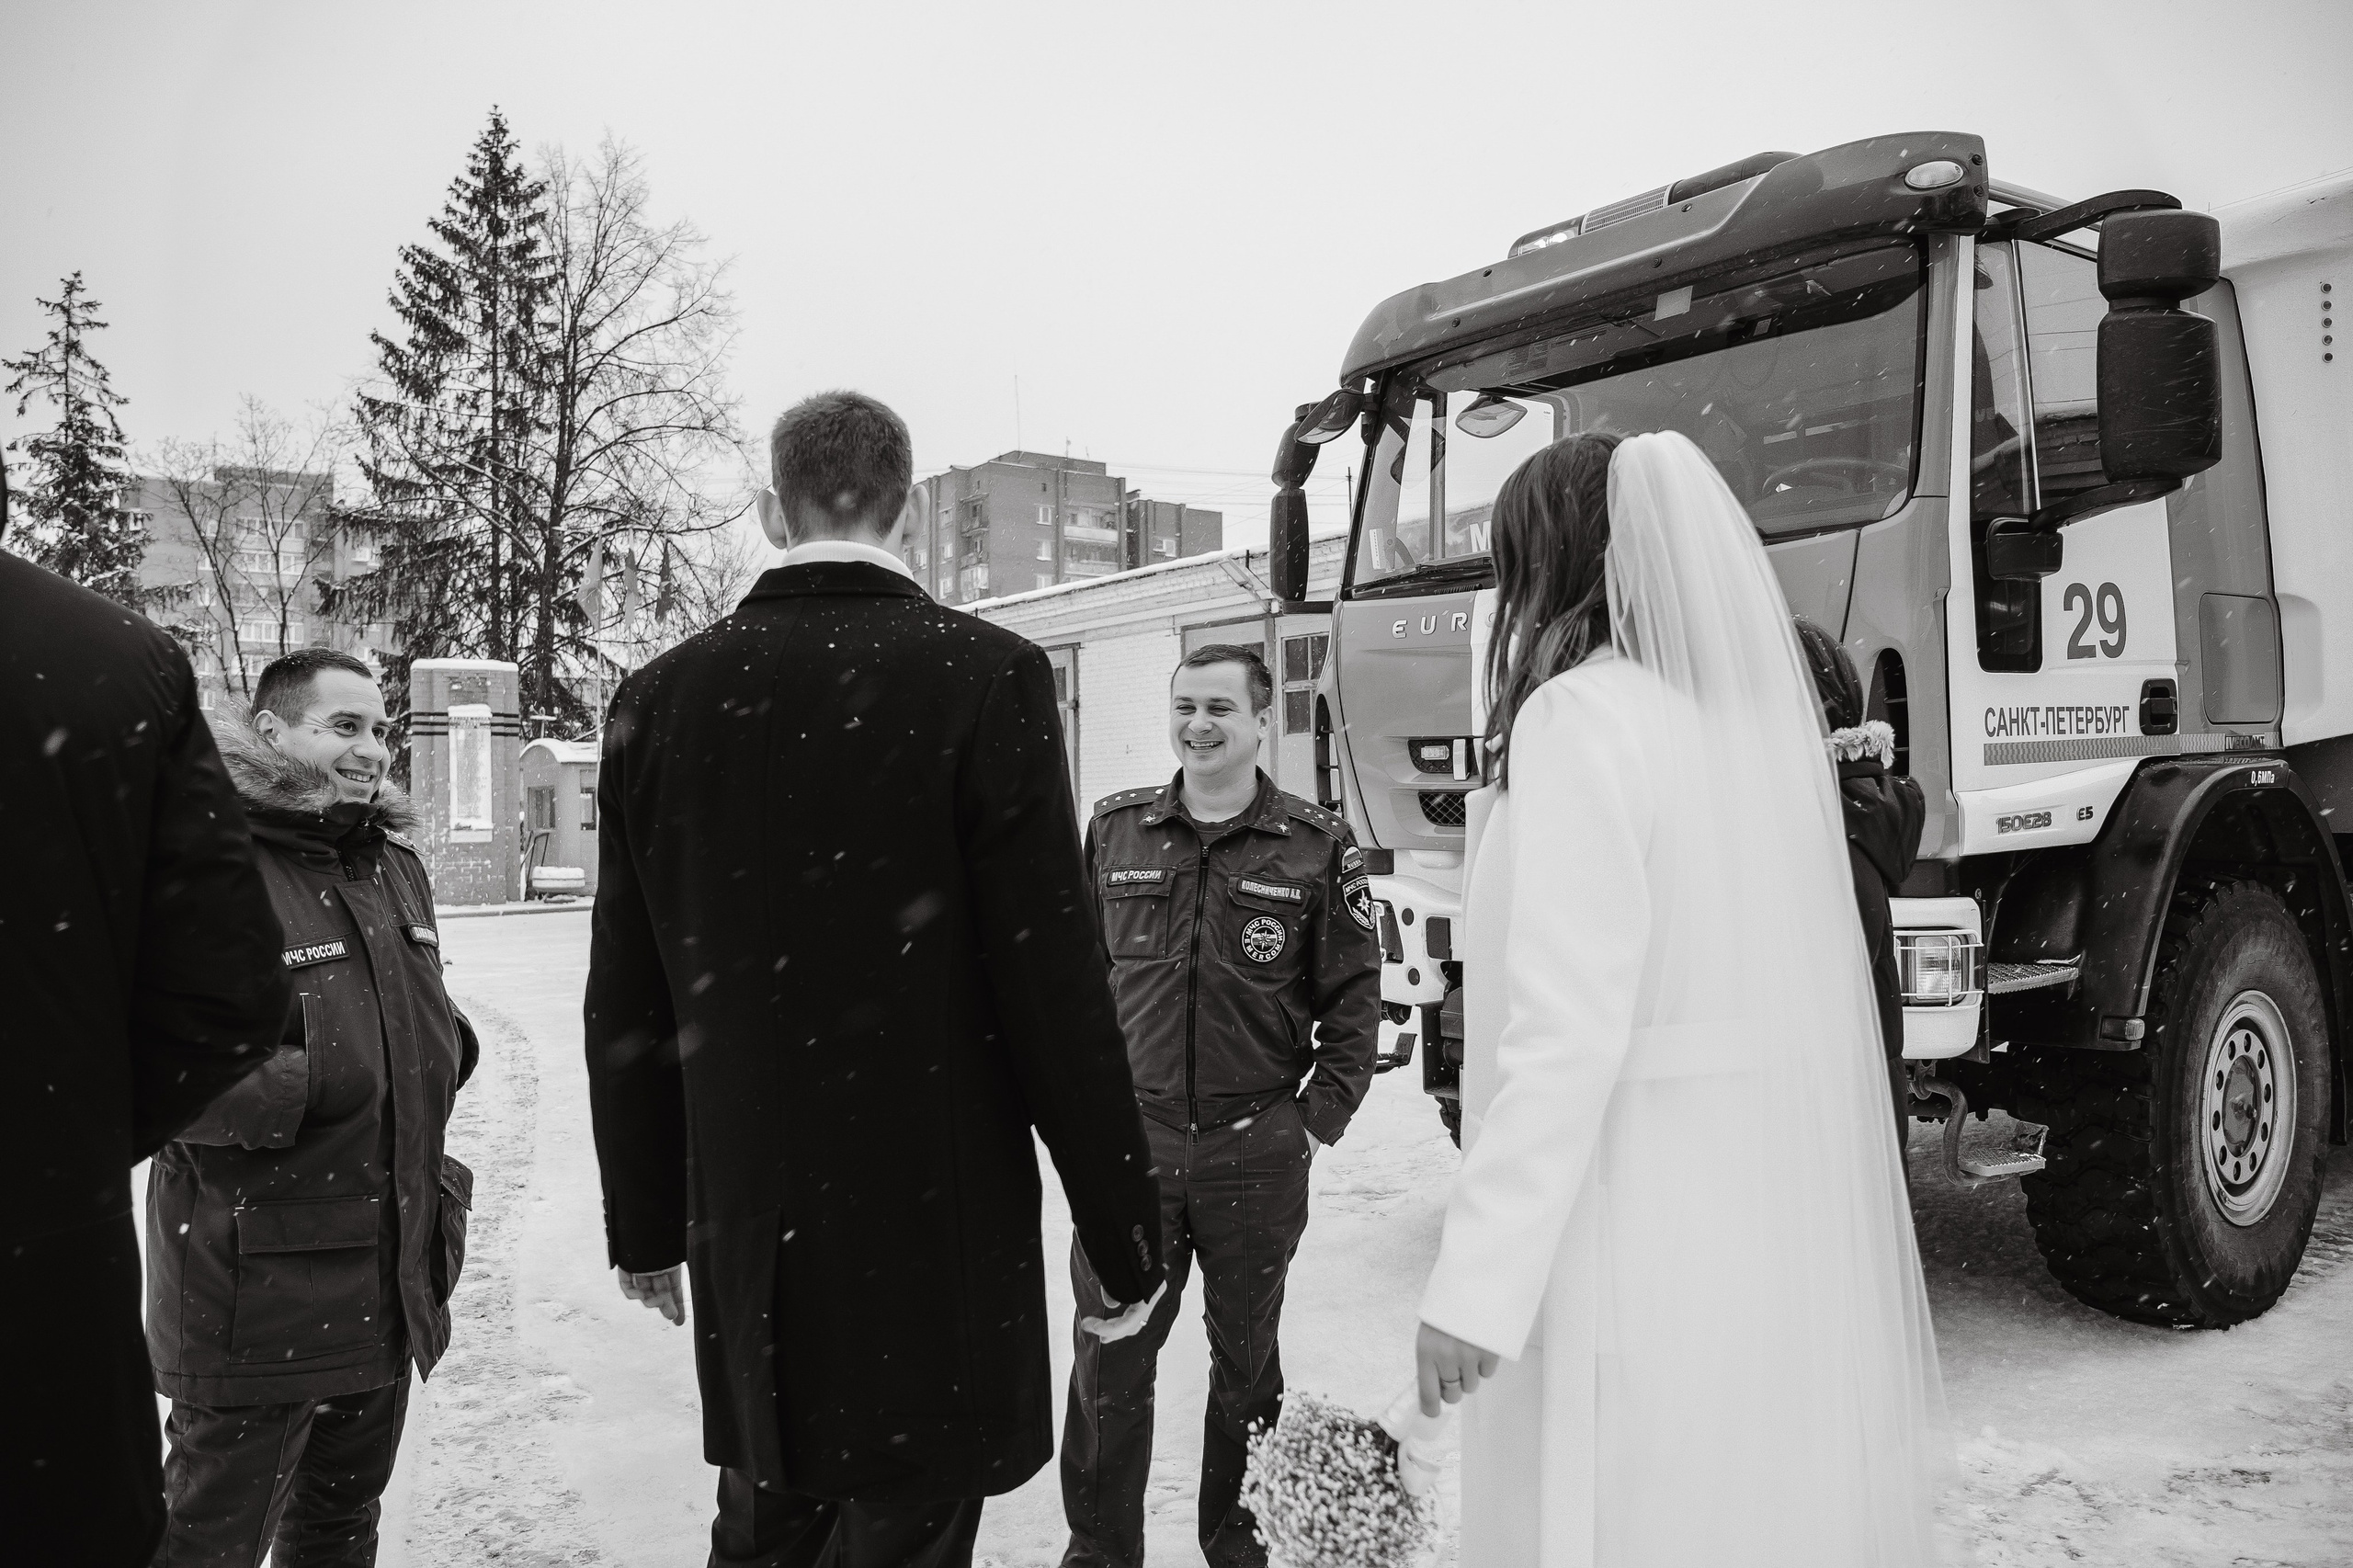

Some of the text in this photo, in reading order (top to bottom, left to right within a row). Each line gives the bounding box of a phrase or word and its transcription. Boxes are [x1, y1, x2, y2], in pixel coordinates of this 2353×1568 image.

[2063, 582, 2127, 660] 29
[1984, 705, 2130, 738] САНКТ-ПЕТЕРБУРГ
[2250, 770, 2276, 787] 0,6МПа
[1995, 805, 2094, 835] 150E28 E5
[1111, 869, 1162, 882] МЧС РОССИИ
[1245, 919, 1283, 941] МЧС РОССИИ
[305, 941, 346, 960] РОССИИ
[1245, 938, 1282, 960] EMERCOM
